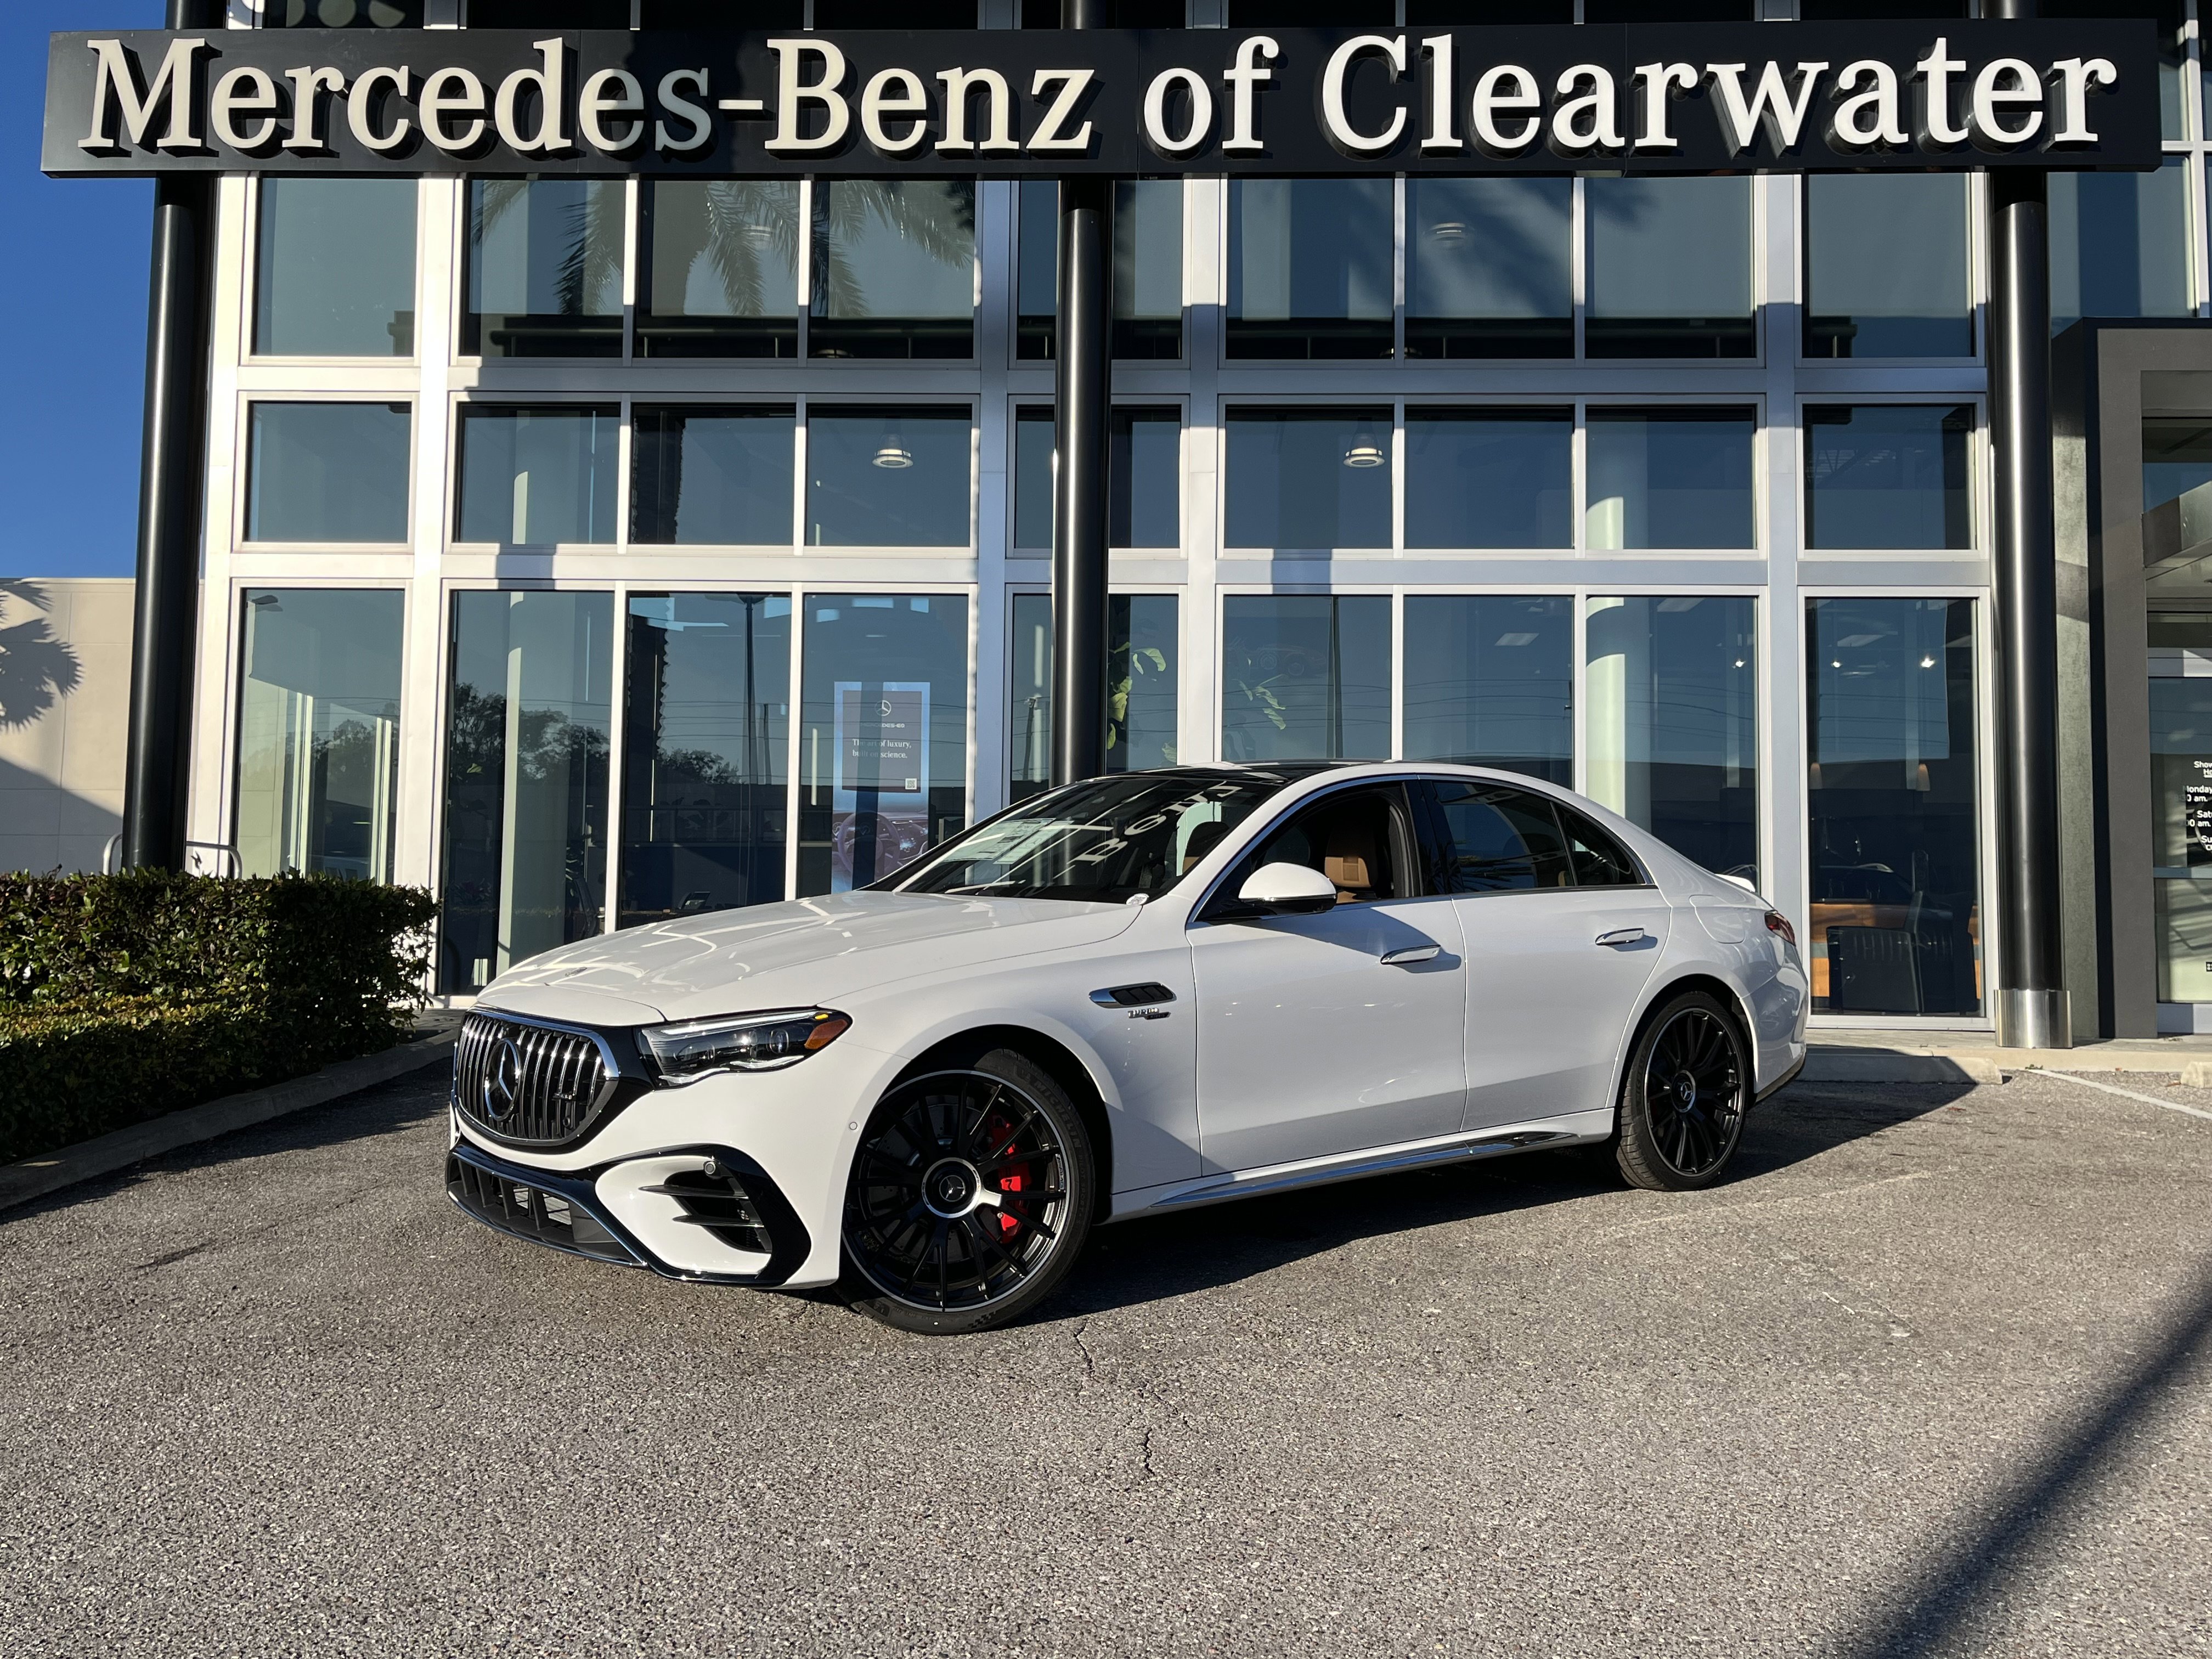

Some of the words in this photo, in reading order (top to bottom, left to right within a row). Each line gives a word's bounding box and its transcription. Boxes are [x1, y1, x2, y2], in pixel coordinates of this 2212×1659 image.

[77, 37, 1095, 151] Mercedes-Benz
[1142, 35, 1279, 154] of
[1323, 32, 2117, 151] Clearwater
[887, 740, 912, 749] luxury,
